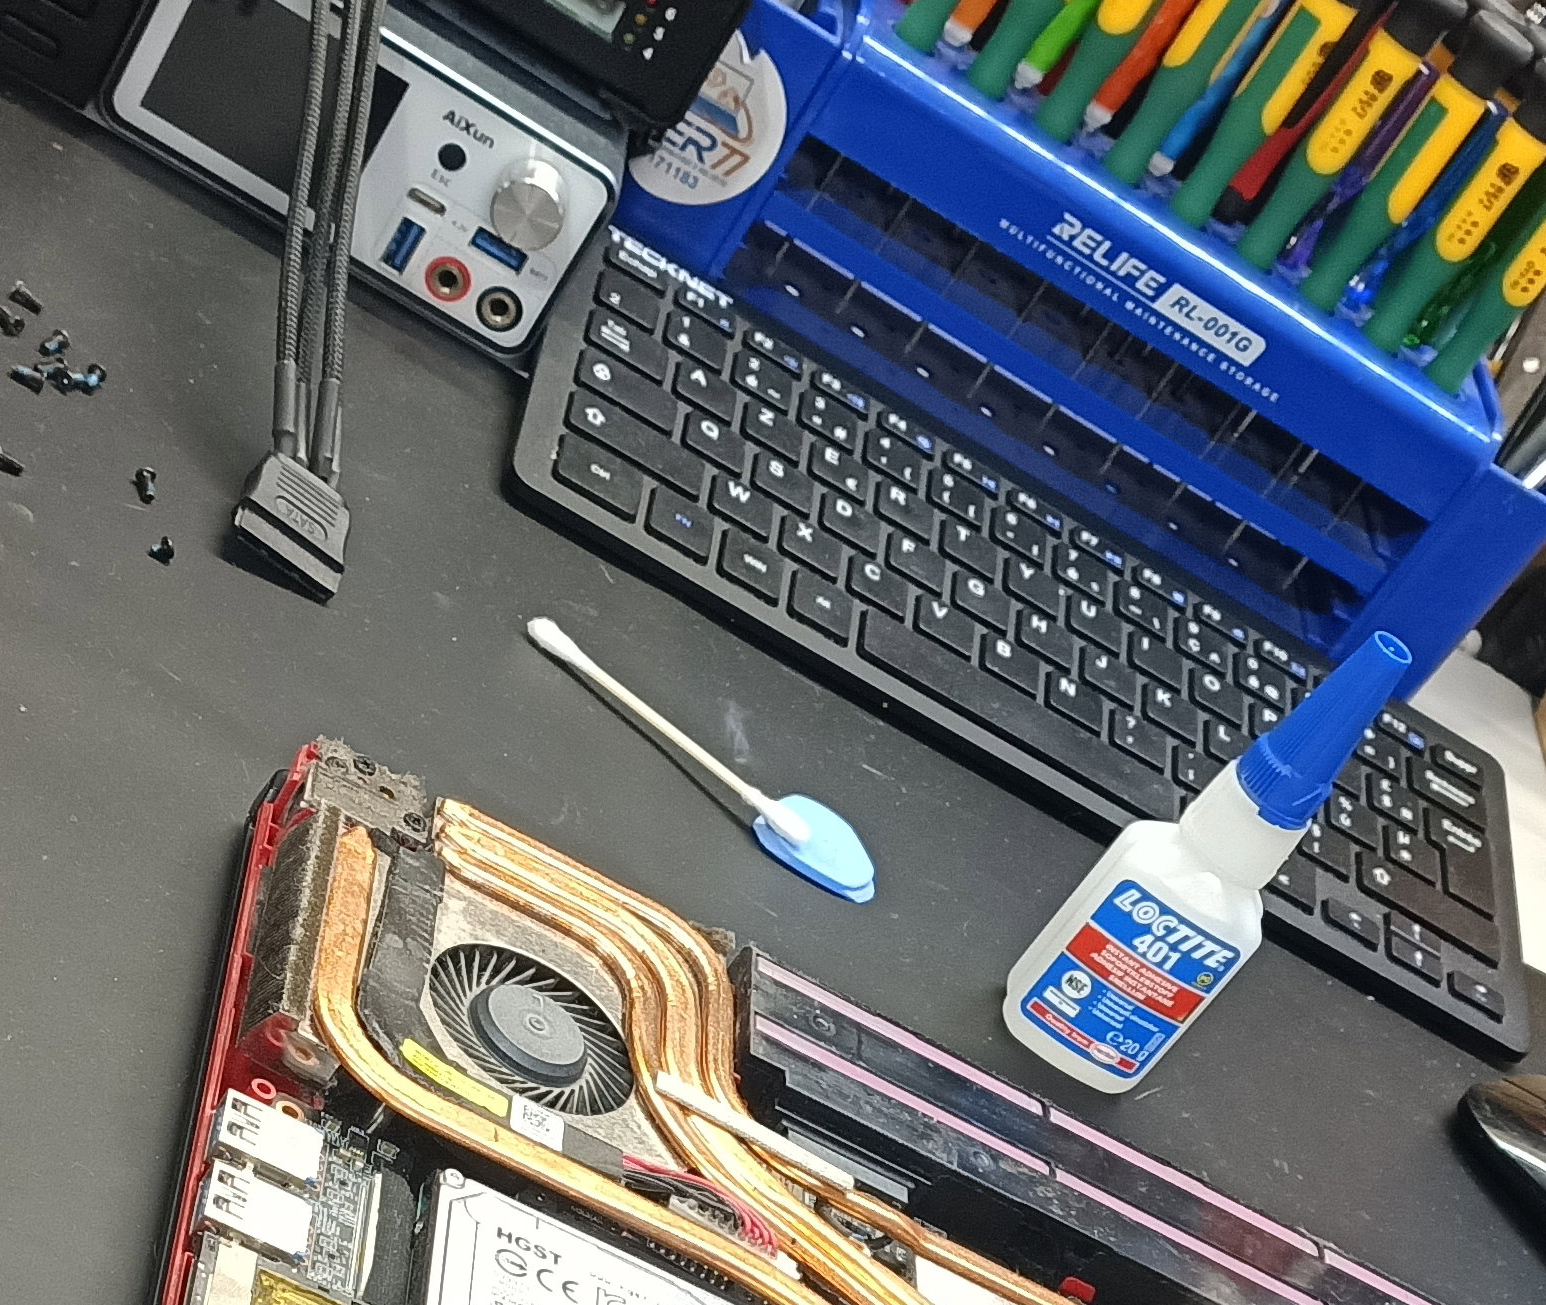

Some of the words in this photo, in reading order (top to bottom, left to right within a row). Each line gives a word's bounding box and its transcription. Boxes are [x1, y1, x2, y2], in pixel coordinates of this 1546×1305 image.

[1052, 211, 1170, 296] RELIFE
[1168, 293, 1255, 355] RL-001G
[690, 369, 707, 387] A
[758, 407, 775, 427] Z
[824, 447, 840, 466] E
[768, 460, 785, 478] S
[728, 481, 751, 503] W
[889, 486, 907, 506] R
[835, 498, 853, 517] D
[796, 522, 814, 542] X
[956, 525, 971, 542] T
[864, 563, 881, 581] C
[1019, 562, 1035, 580] Y
[931, 601, 948, 619] V
[1080, 600, 1097, 618] U
[1031, 614, 1048, 634] H
[996, 637, 1014, 658] B
[1059, 677, 1077, 697] N
[1156, 688, 1172, 707] K
[1217, 724, 1231, 742] L
[1113, 888, 1229, 971] LOCTITE
[1132, 933, 1182, 971] 401
[1119, 1037, 1139, 1056] 20
[1135, 1048, 1149, 1063] g
[495, 1226, 563, 1266] HGST
